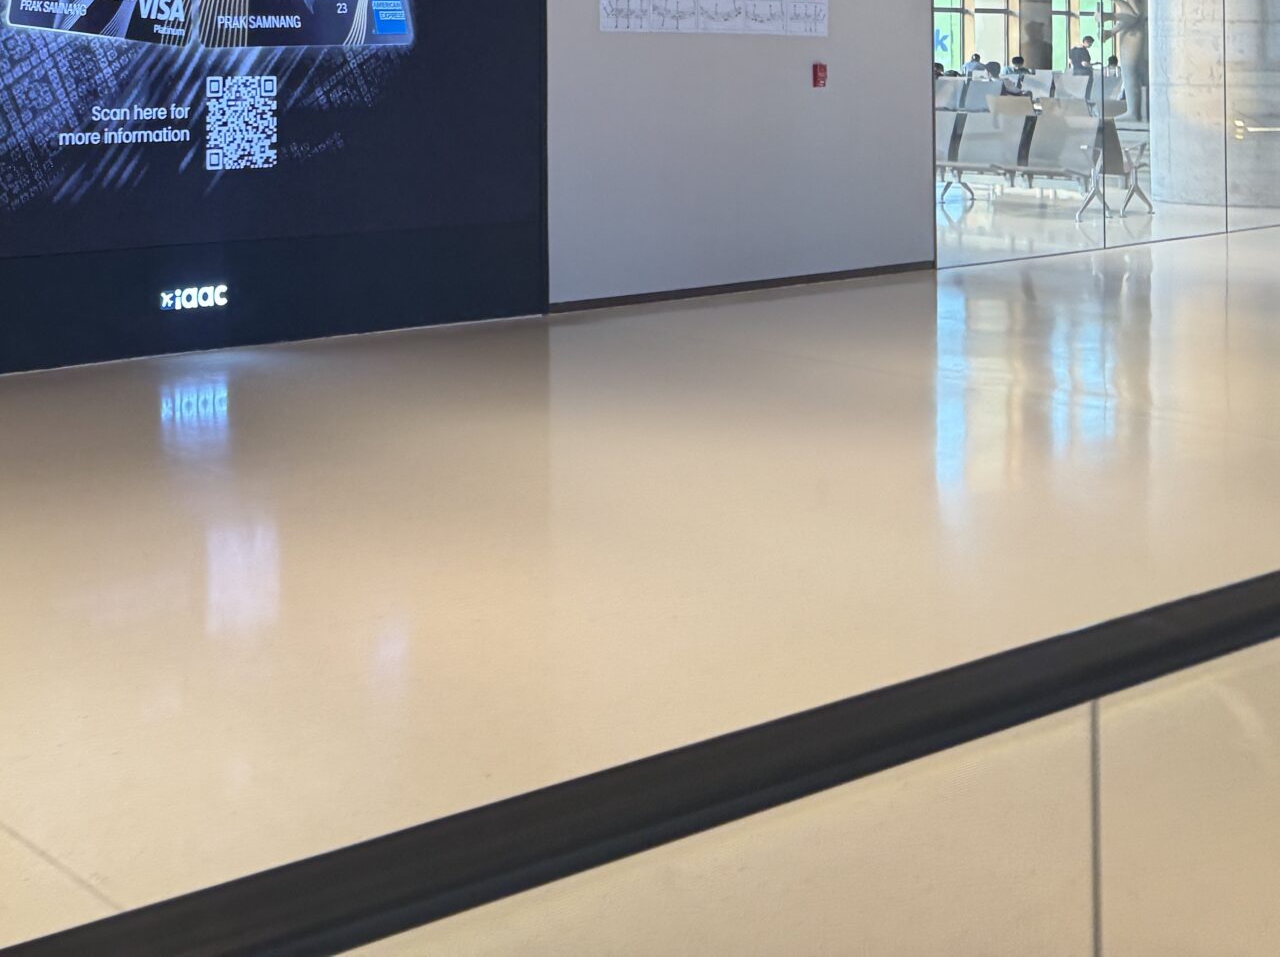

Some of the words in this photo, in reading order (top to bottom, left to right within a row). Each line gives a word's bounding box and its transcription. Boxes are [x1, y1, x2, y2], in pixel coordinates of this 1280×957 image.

[20, 0, 44, 12] PRAK
[44, 0, 88, 17] SAMNANG
[336, 3, 348, 14] 23
[217, 15, 247, 28] PRAK
[248, 15, 302, 29] SAMNANG
[91, 105, 130, 122] Scan
[133, 104, 167, 120] here
[170, 103, 191, 119] for
[58, 130, 101, 146] more
[104, 127, 191, 145] information
[174, 284, 229, 310] iaac
